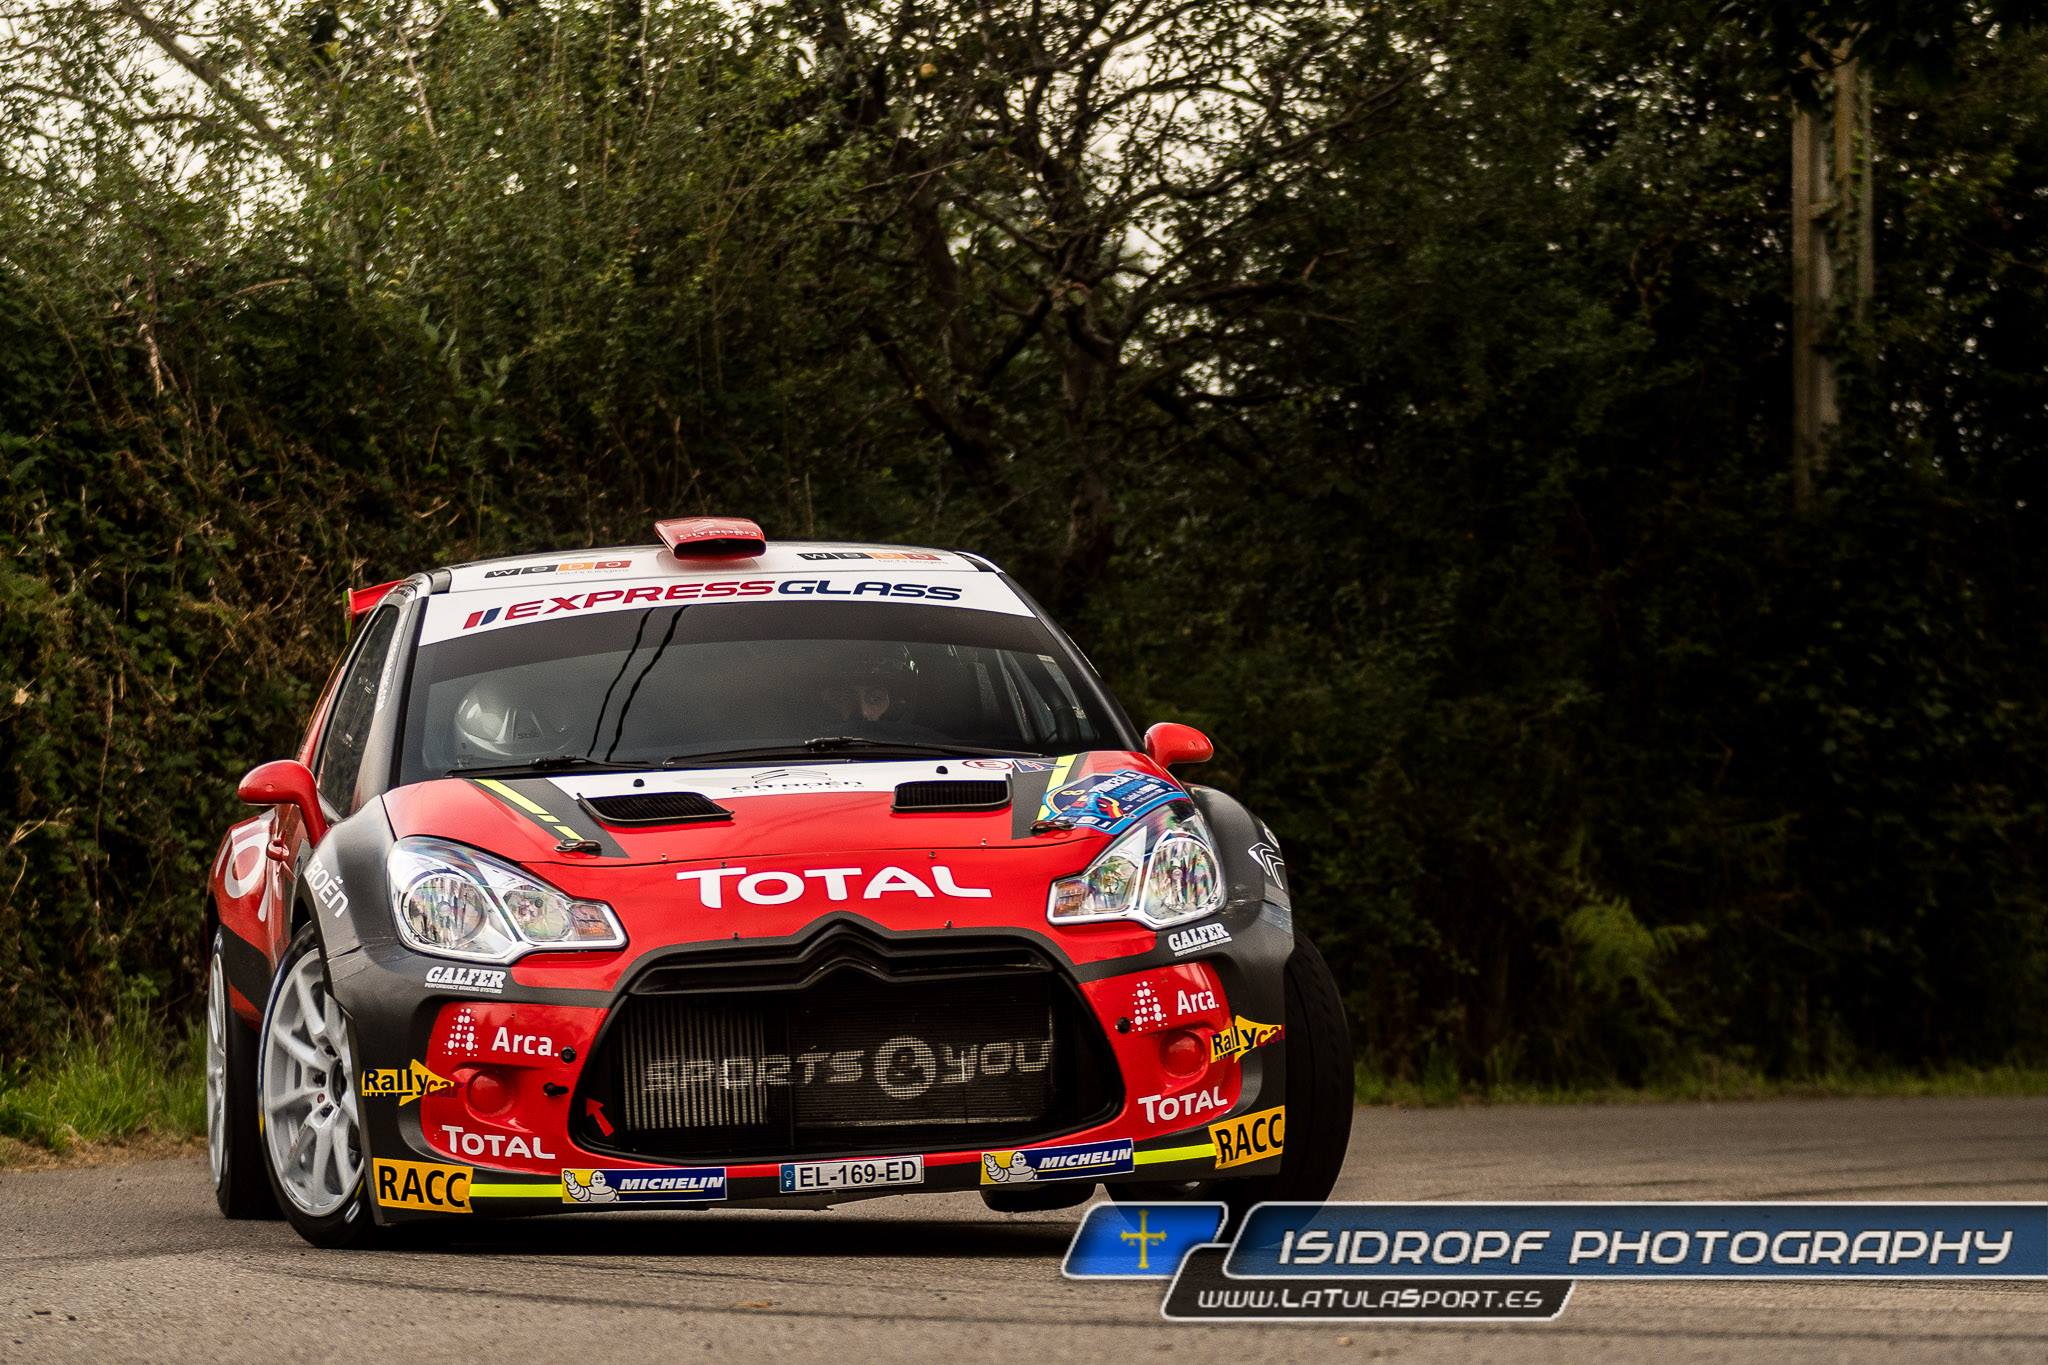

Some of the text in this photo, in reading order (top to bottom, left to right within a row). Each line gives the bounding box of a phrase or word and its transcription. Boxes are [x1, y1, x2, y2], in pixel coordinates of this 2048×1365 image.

[504, 580, 963, 621] EXPRESSGLASS
[676, 866, 993, 909] TOTAL
[1168, 923, 1230, 952] GALFER
[426, 966, 506, 988] GALFER
[1138, 1086, 1228, 1124] TOTAL
[442, 1125, 556, 1159] TOTAL
[1215, 1113, 1283, 1163] RACC
[799, 1160, 917, 1188] EL-169-ED
[1038, 1148, 1133, 1169] MICHELIN
[379, 1165, 467, 1207] RACC
[619, 1176, 724, 1191] MICHELIN
